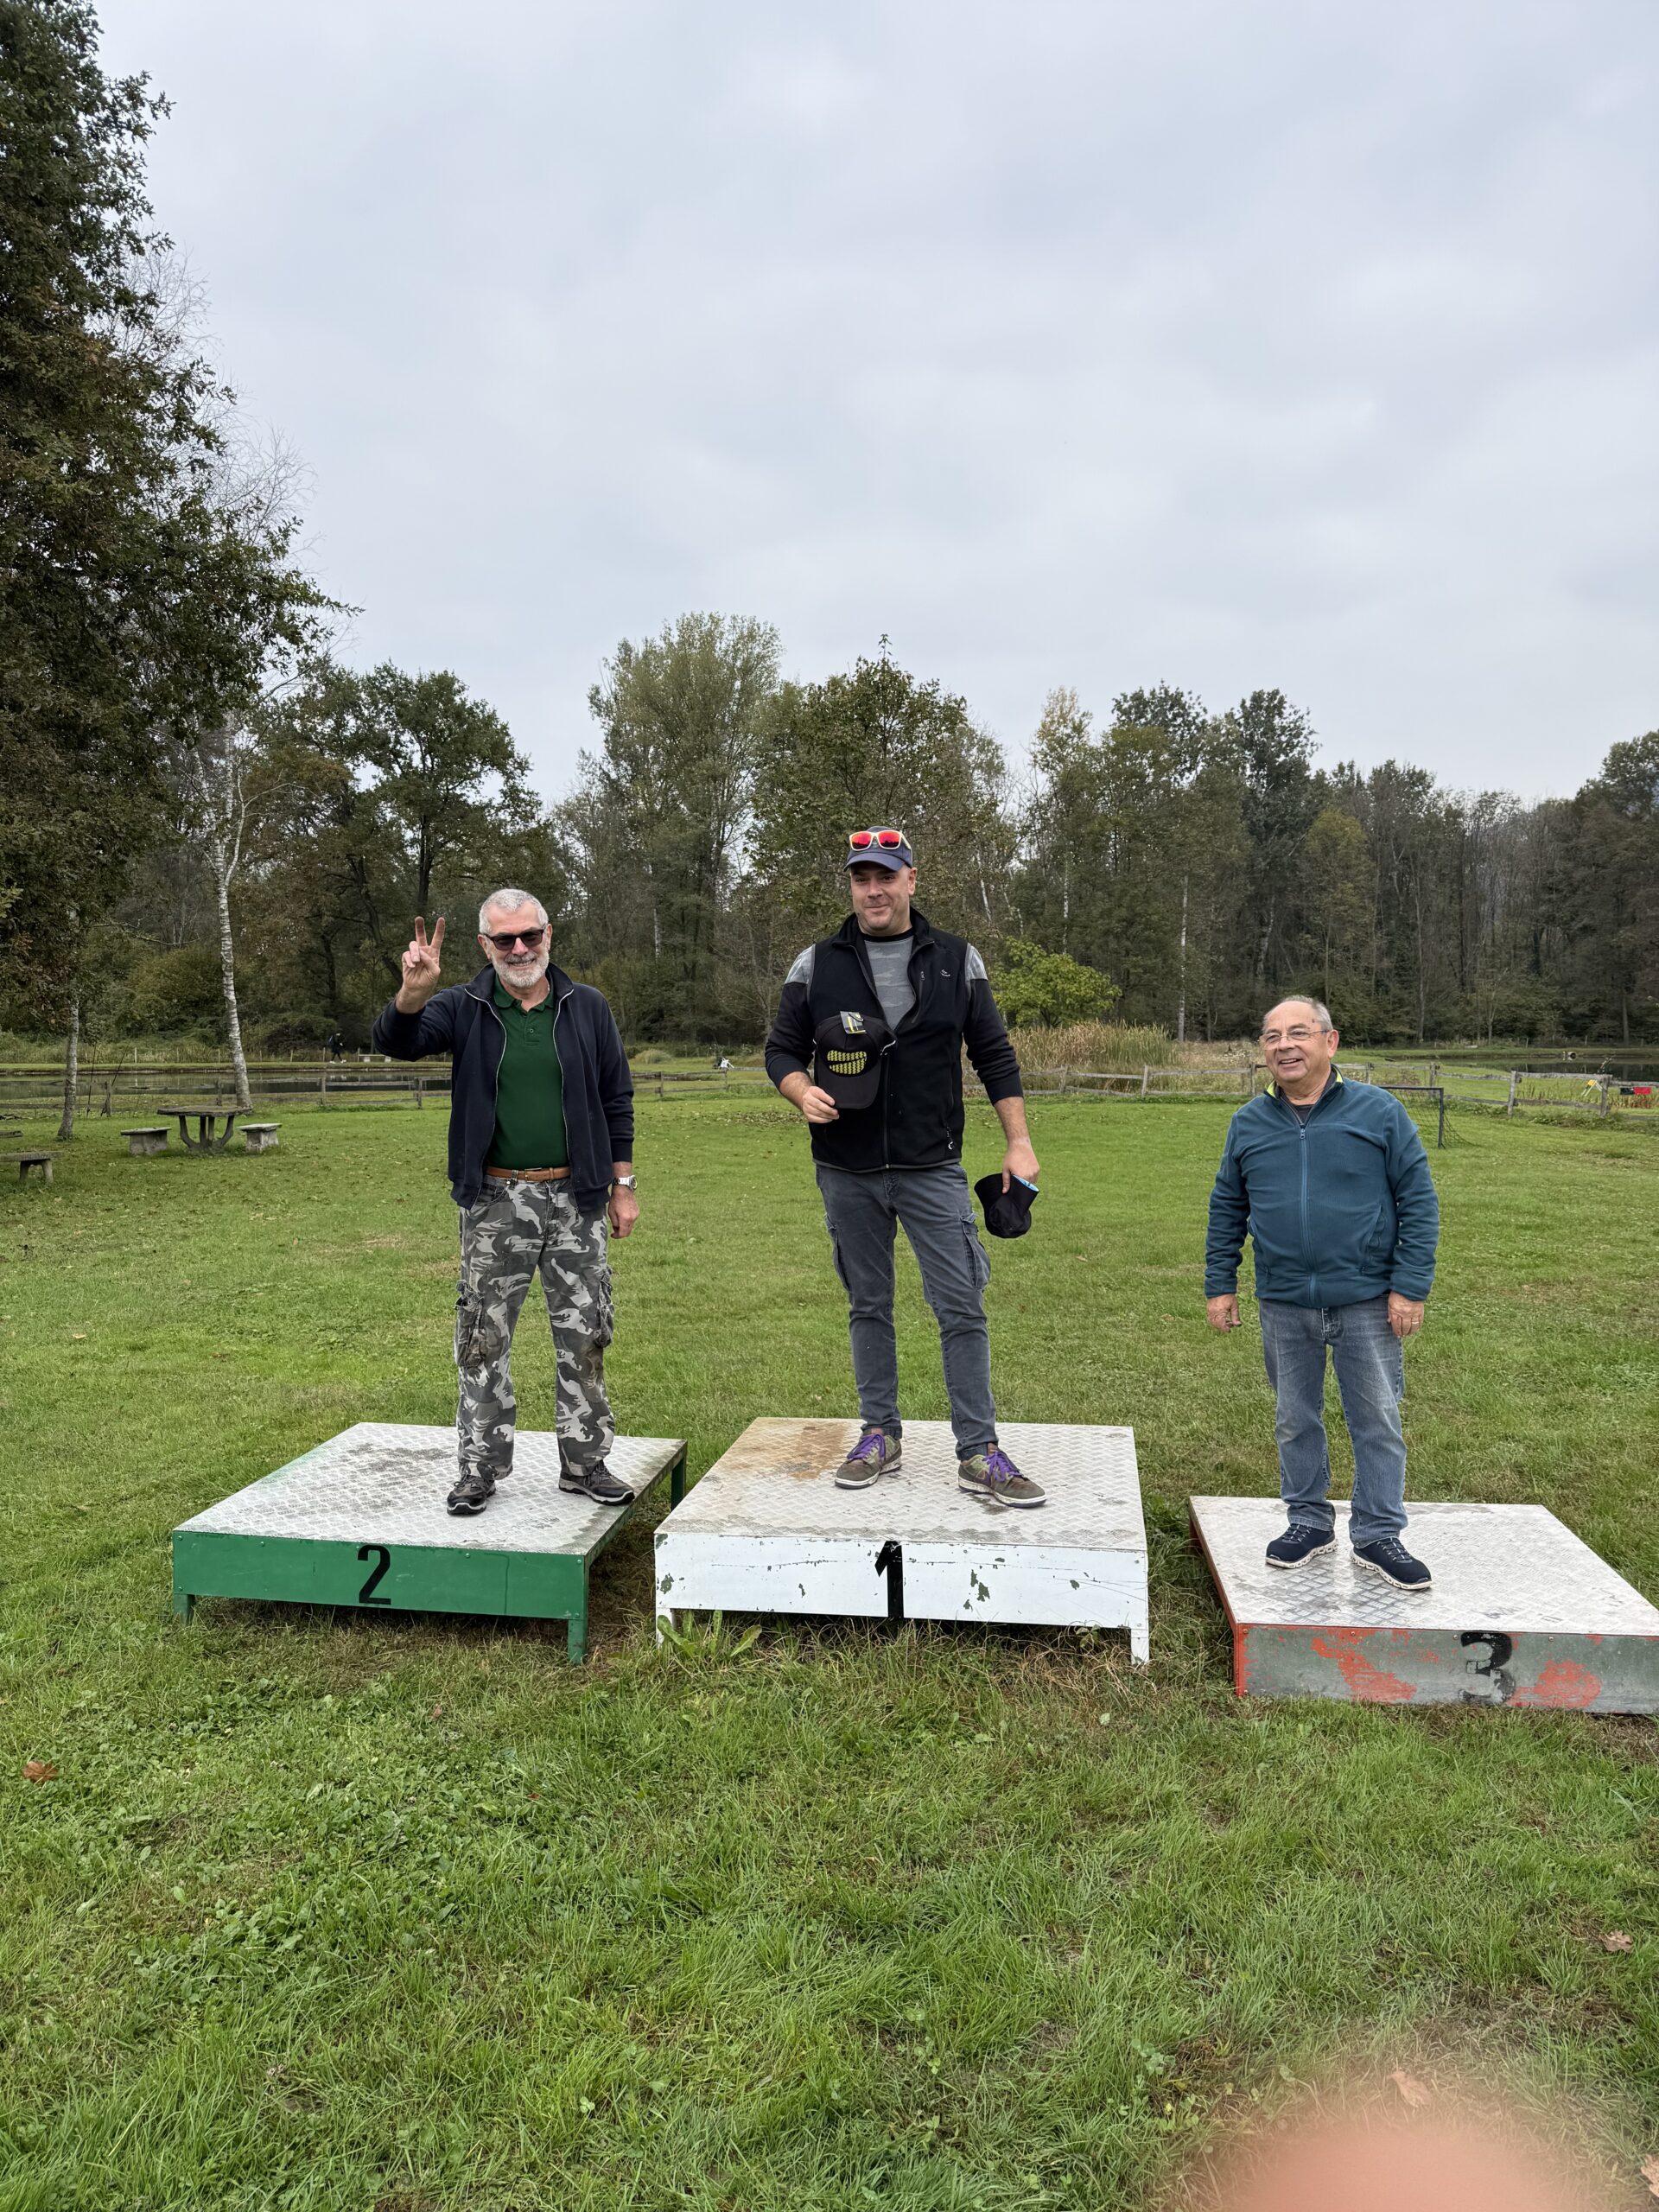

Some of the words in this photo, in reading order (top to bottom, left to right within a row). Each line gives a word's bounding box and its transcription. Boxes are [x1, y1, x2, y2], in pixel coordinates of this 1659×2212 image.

[358, 1545, 391, 1605] 2
[874, 1541, 904, 1618] 1
[1459, 1631, 1516, 1704] 3
